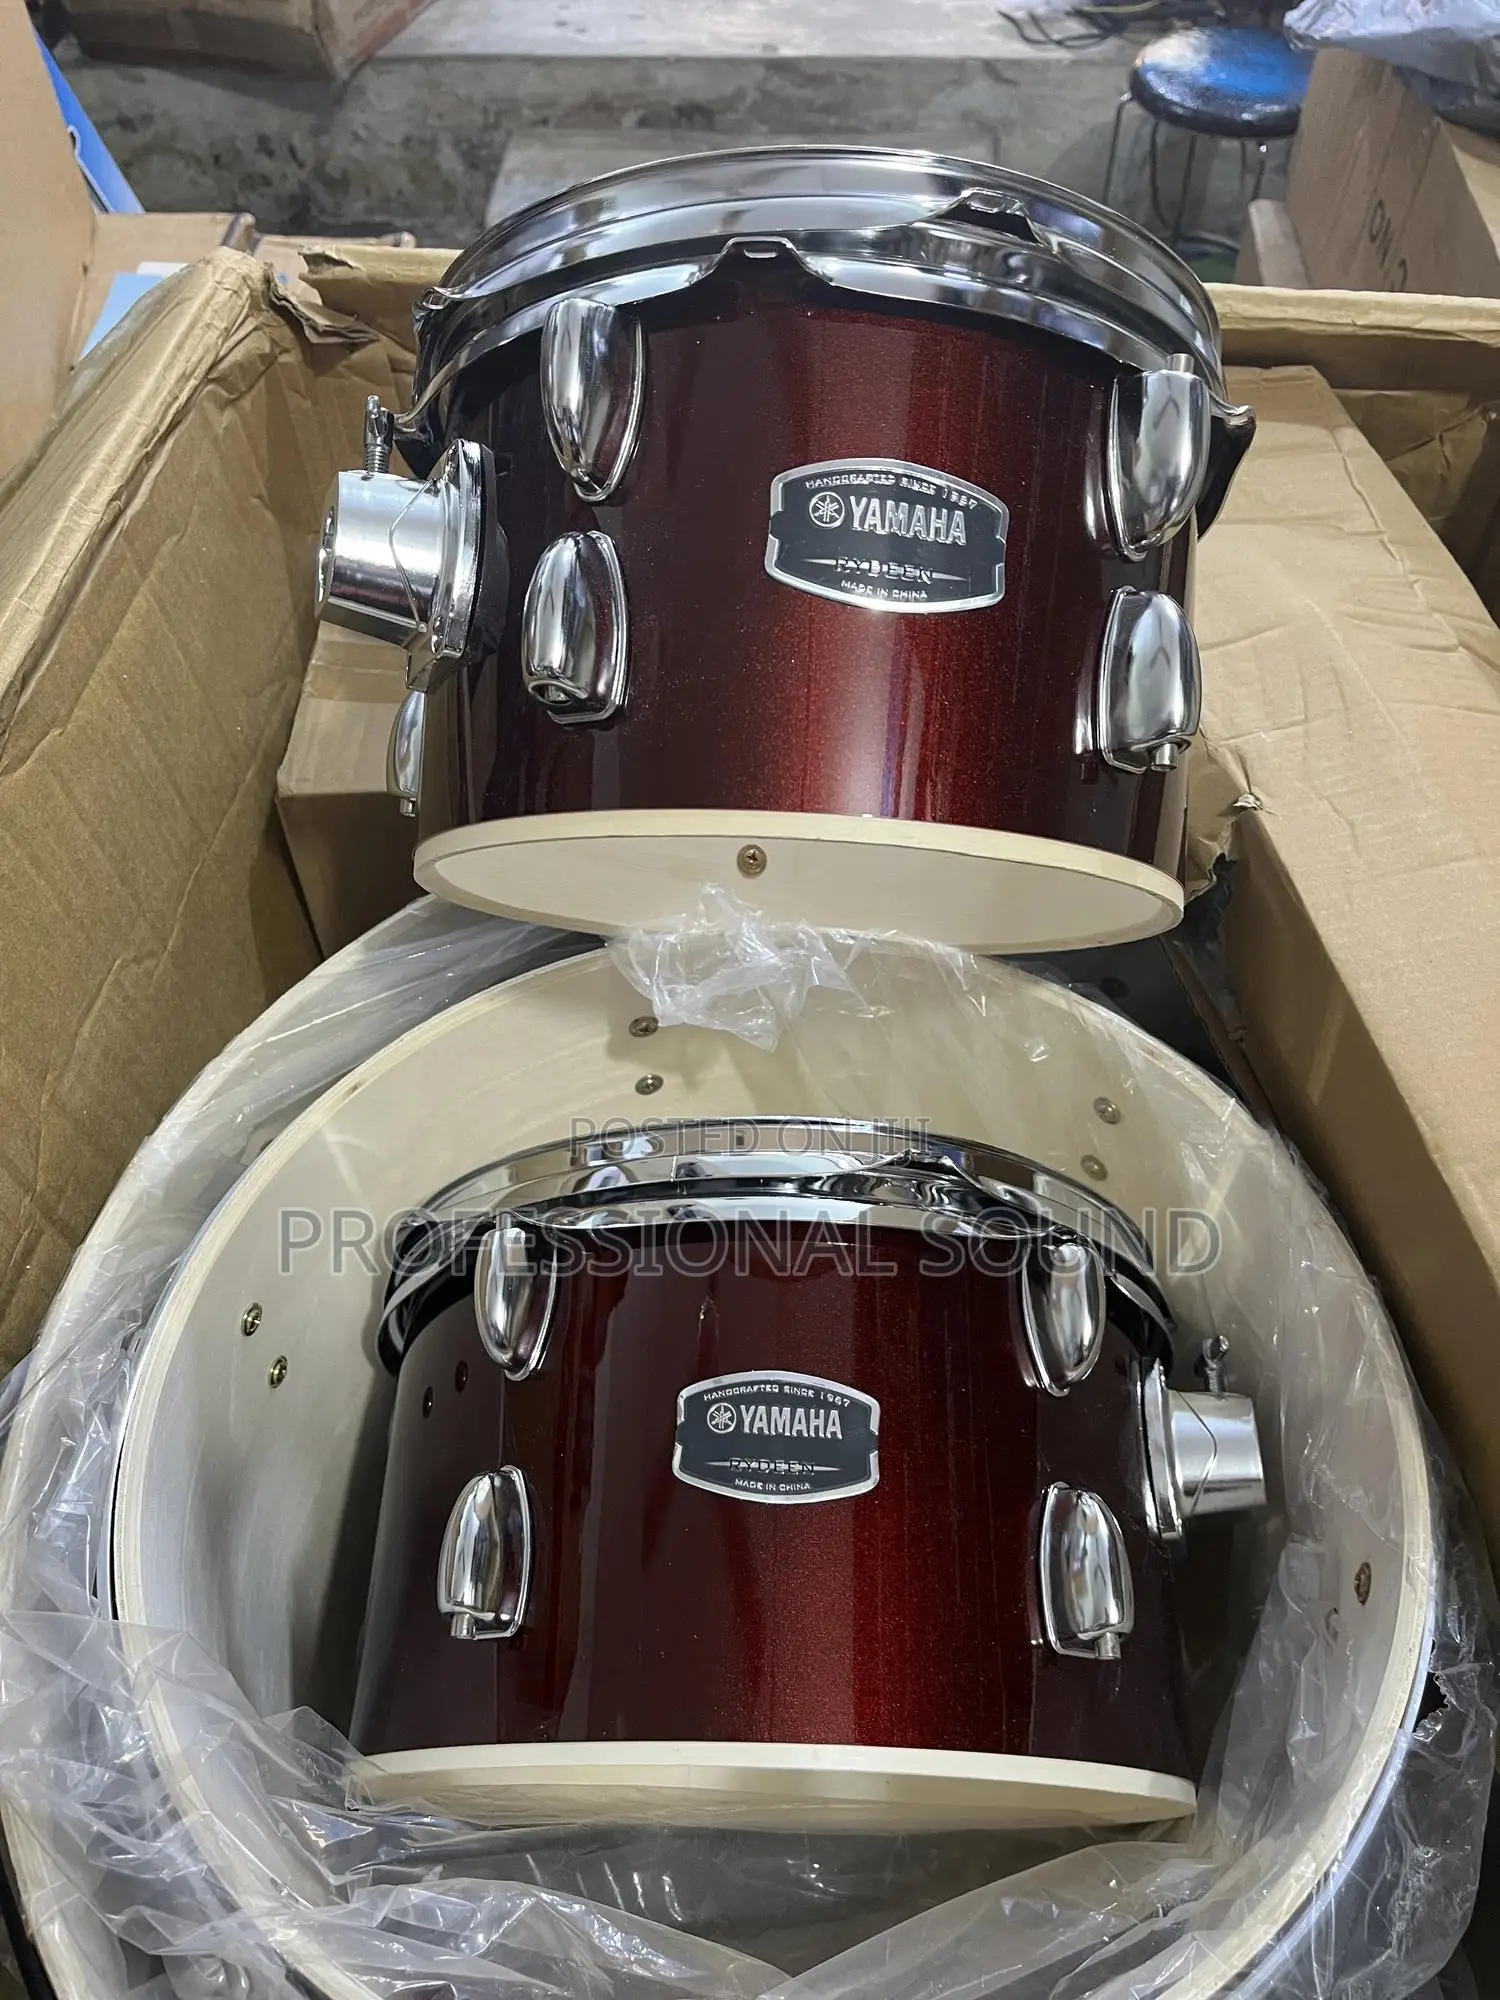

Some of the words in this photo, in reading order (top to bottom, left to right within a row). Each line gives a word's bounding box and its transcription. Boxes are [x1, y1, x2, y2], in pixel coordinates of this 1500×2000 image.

[849, 495, 967, 546] YAMAHA
[836, 557, 934, 584] RYDEEN
[841, 580, 875, 597] MADE
[876, 587, 889, 598] IN
[892, 589, 928, 600] CHINA
[703, 1384, 779, 1402] HANDCRAFTED
[783, 1385, 815, 1398] SINCE
[820, 1391, 851, 1408] 1967
[739, 1404, 843, 1440] YAMAHA
[728, 1457, 816, 1476] RYDEEN
[734, 1478, 764, 1491] MADE
[765, 1482, 777, 1492] IN
[779, 1482, 811, 1492] CHINA
